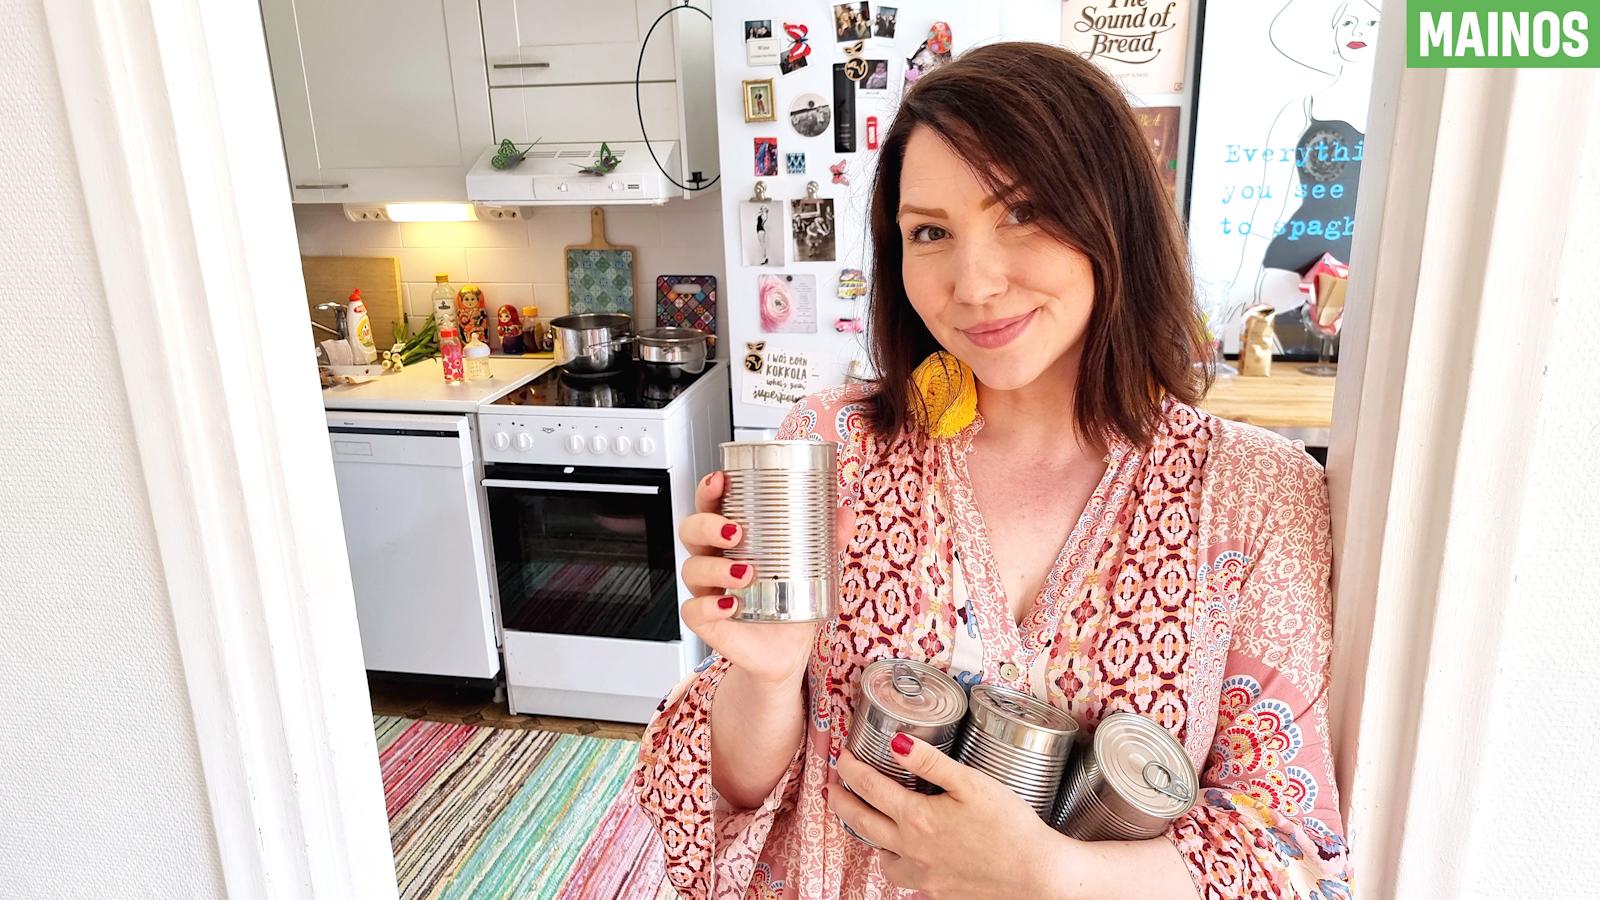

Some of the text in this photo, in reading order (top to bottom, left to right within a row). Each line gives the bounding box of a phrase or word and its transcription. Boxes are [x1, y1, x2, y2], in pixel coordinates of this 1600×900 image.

[1076, 2, 1176, 32] Sound of
[1083, 31, 1159, 62] Bread
[1224, 140, 1363, 168] Everythi
[1222, 183, 1345, 205] you see
[1220, 217, 1252, 235] to
[766, 364, 808, 380] KOKKOLA
